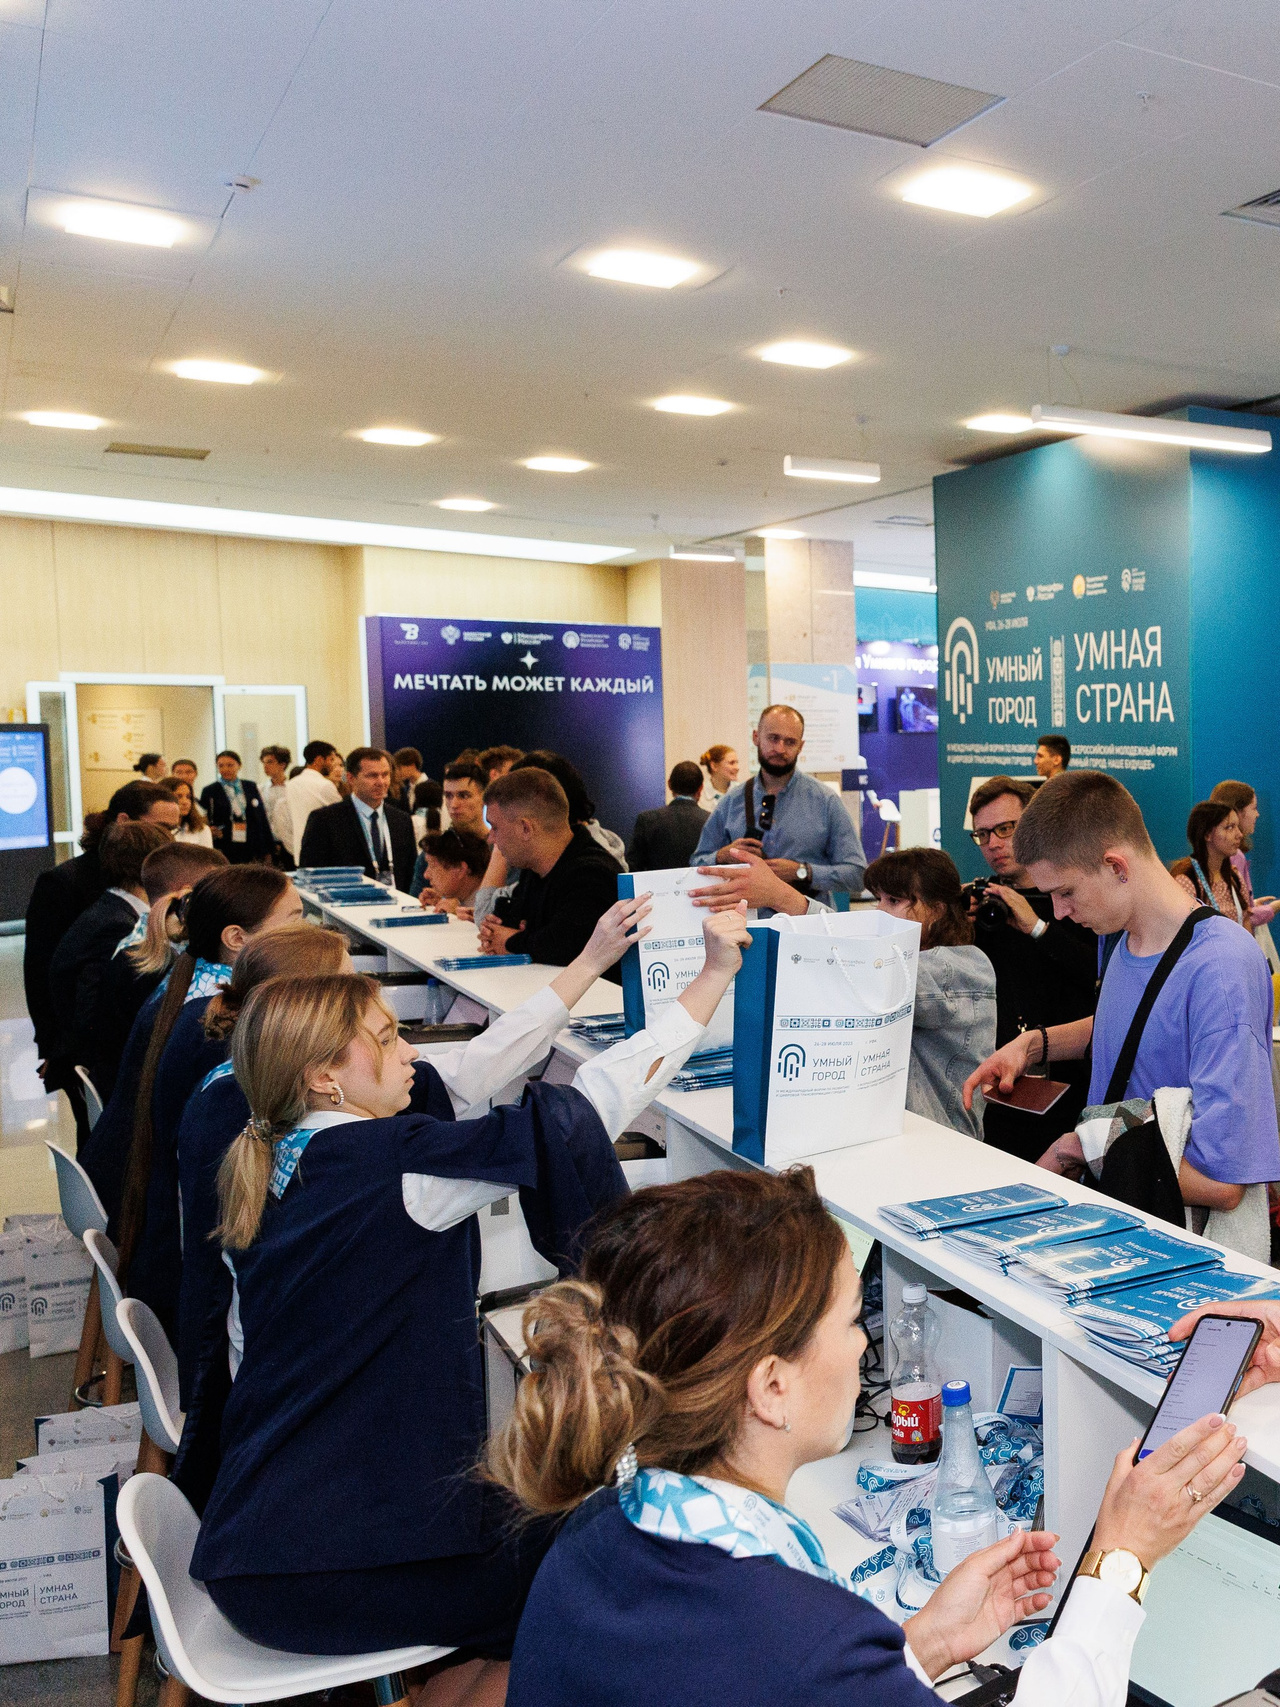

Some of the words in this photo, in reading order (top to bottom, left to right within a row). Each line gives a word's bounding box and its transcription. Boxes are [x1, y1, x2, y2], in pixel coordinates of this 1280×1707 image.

[1074, 625, 1162, 671] УМНАЯ
[986, 647, 1042, 683] УМНЫЙ
[393, 674, 487, 691] МЕЧТАТЬ
[492, 676, 565, 692] МОЖЕТ
[571, 675, 654, 695] КАЖДЫЙ
[988, 696, 1037, 727] ГОРОД
[1076, 681, 1174, 723] СТРАНА
[675, 969, 702, 979] УМНЫ
[813, 1055, 852, 1067] УМНЫЙ
[862, 1048, 891, 1064] УМНАЯ
[812, 1070, 845, 1081] ГОРОД
[861, 1060, 891, 1077] СТРАНА
[0, 1587, 29, 1599] МНЫЙ
[40, 1582, 74, 1594] УМНАЯ
[0, 1600, 26, 1610] ОРОД
[40, 1593, 78, 1605] СТРАНА
